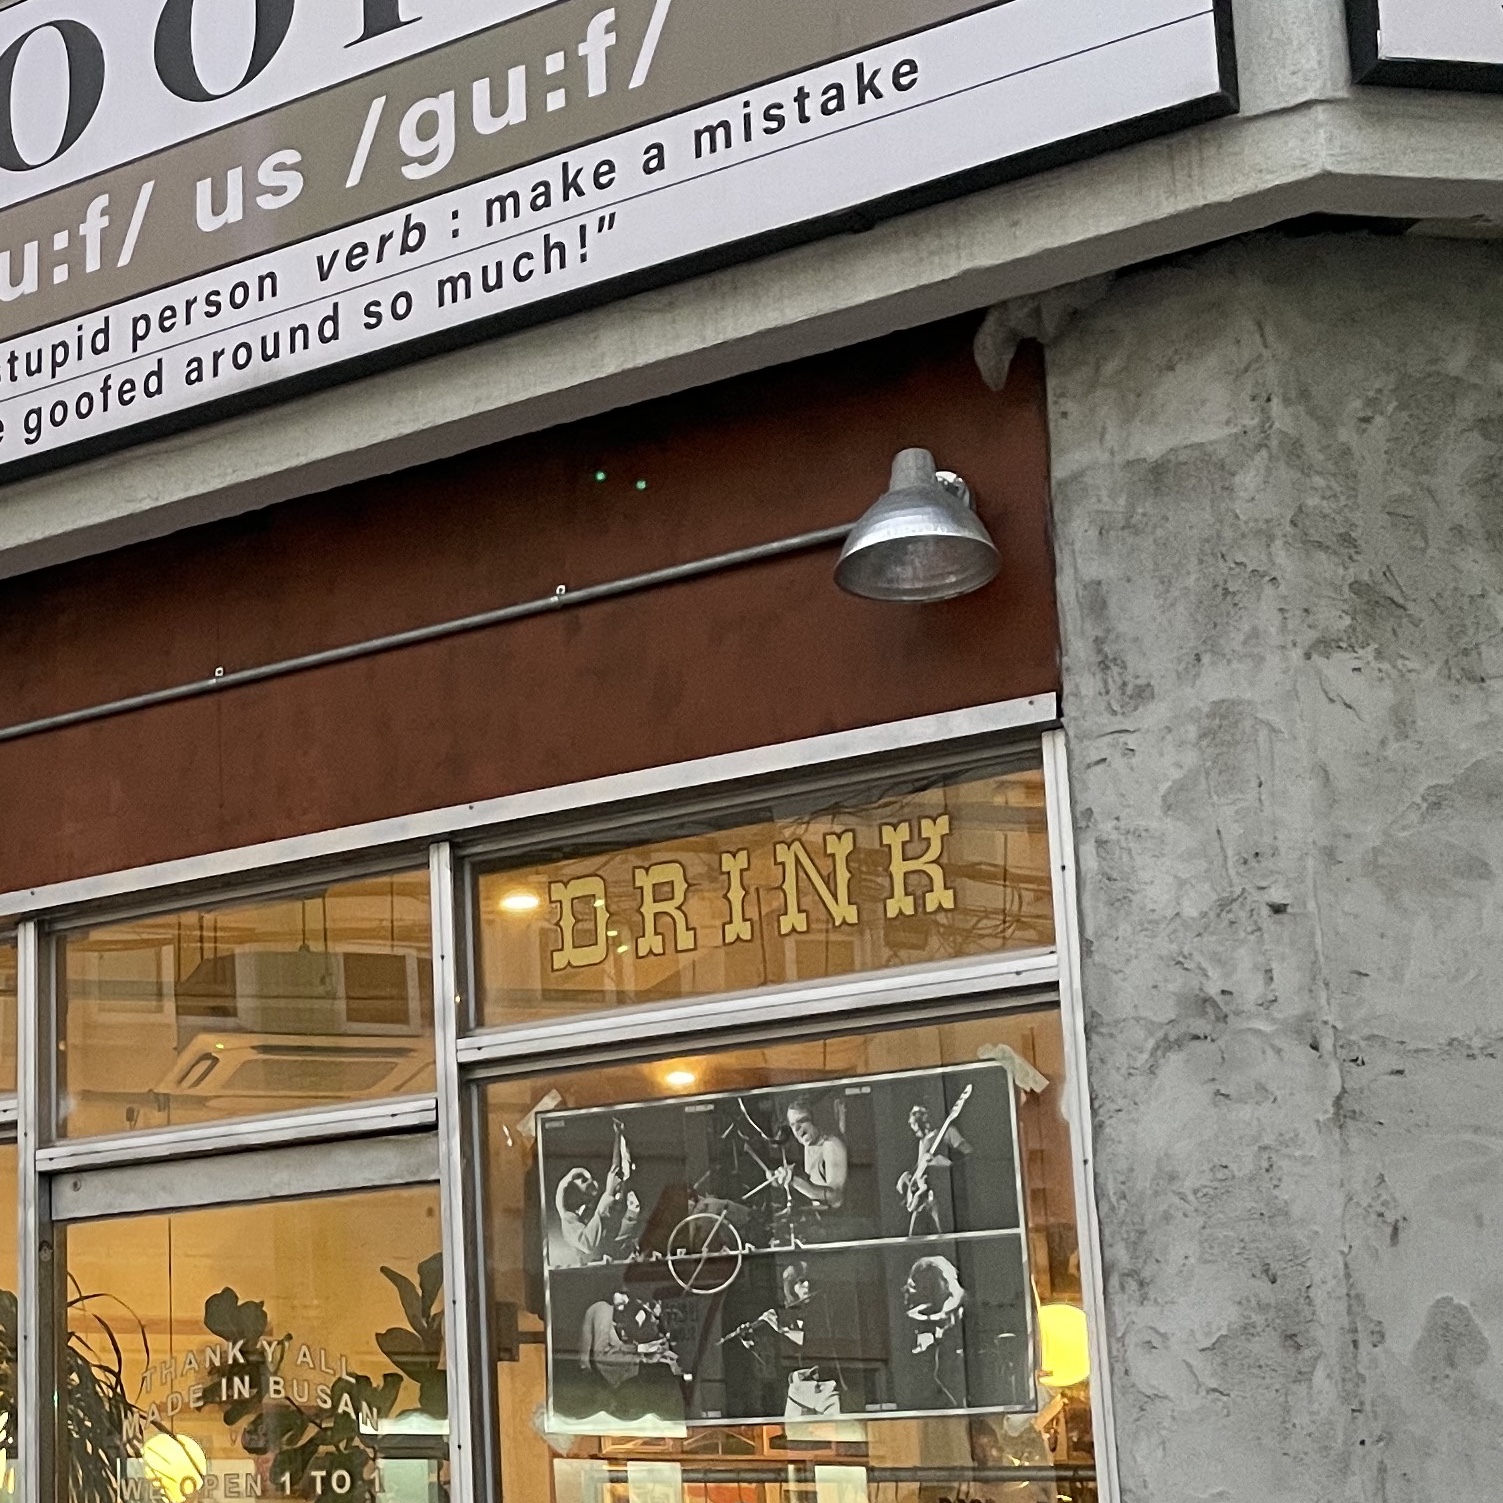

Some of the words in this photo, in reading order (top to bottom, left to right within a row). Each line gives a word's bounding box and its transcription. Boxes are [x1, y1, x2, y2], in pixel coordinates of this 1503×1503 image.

[130, 267, 279, 354] person
[315, 215, 428, 284] verb
[485, 153, 617, 228] make
[641, 140, 665, 175] a
[694, 56, 921, 160] mistake
[195, 147, 304, 232] us
[24, 355, 164, 444] goofed
[184, 301, 341, 386] around
[363, 290, 413, 330] so
[548, 814, 956, 972] DRINK
[122, 1383, 205, 1442] MADE
[220, 1375, 251, 1400] IN
[268, 1374, 380, 1432] BUSAN
[142, 1339, 246, 1393] THANK
[179, 1472, 263, 1499] OPEN
[279, 1471, 292, 1495] 1
[310, 1469, 351, 1495] TO
